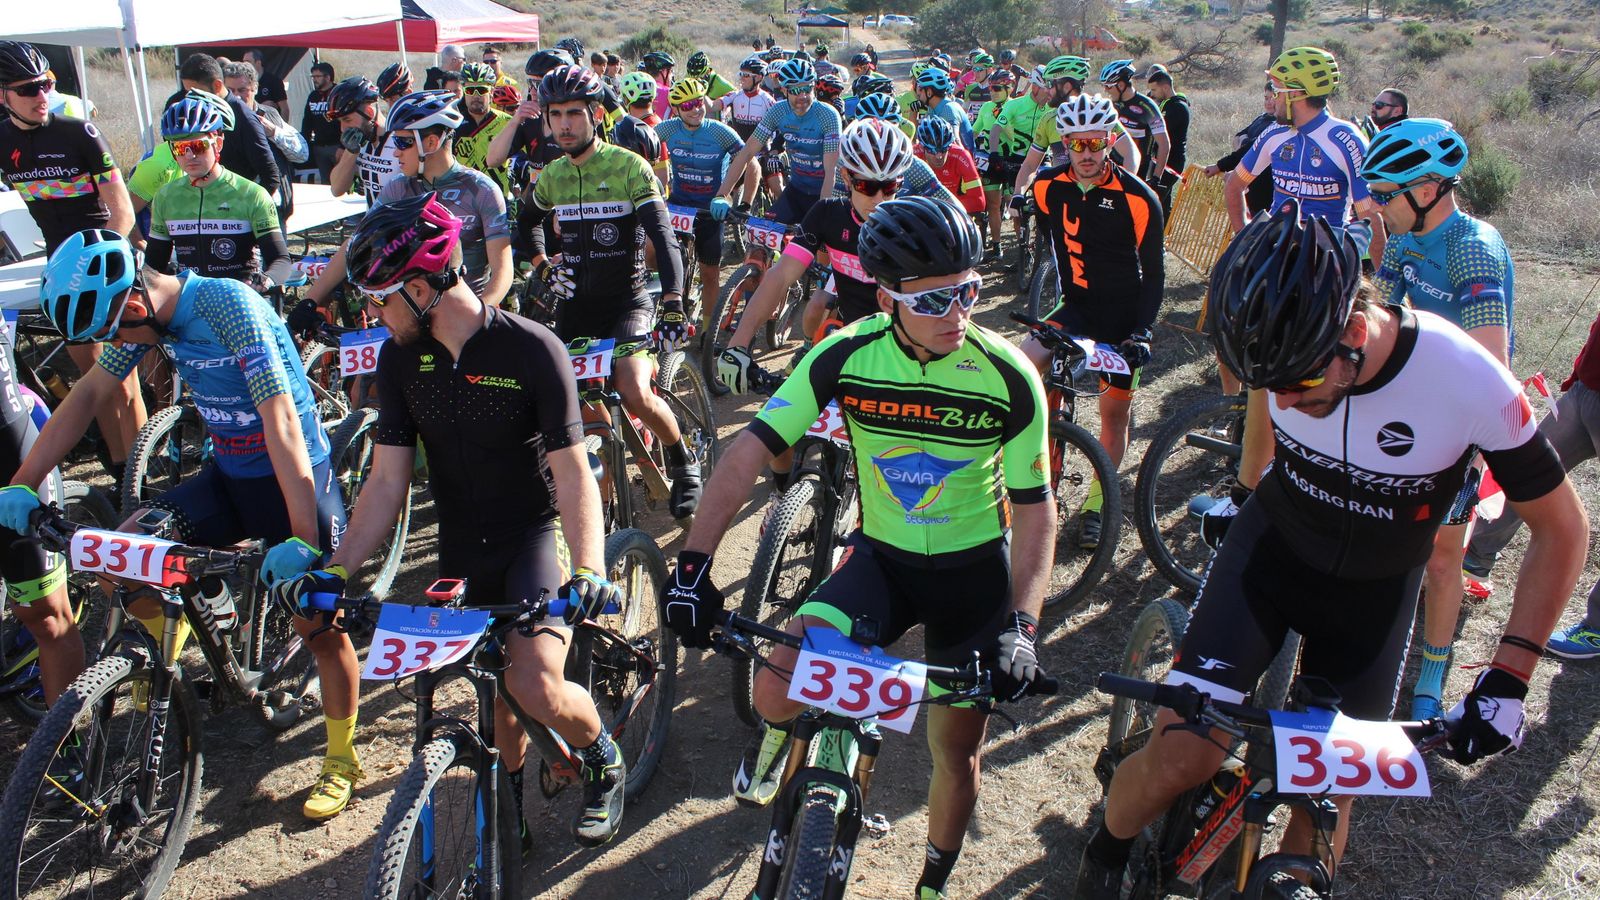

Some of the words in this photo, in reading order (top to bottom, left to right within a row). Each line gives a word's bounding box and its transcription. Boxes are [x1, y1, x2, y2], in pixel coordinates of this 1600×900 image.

[562, 205, 600, 217] AVENTURA
[602, 205, 624, 214] BIKE
[176, 222, 219, 231] AVENTURA
[221, 223, 243, 231] BIKE
[382, 226, 419, 257] KASK
[1089, 350, 1127, 372] 385
[477, 381, 522, 390] MONTOYA
[483, 376, 517, 384] CICLOS
[844, 395, 940, 420] PEDAL
[1274, 428, 1438, 488] SILVERBACK
[882, 467, 935, 485] GMA
[1352, 478, 1436, 496] RACING
[904, 513, 951, 525] SEGUROS
[79, 534, 157, 577] 331
[399, 626, 432, 634] DIPUTACIÓN
[372, 637, 472, 677] 337
[865, 656, 875, 664] DE
[799, 659, 913, 721] 339
[146, 715, 167, 773] FOX
[1288, 735, 1418, 790] 336
